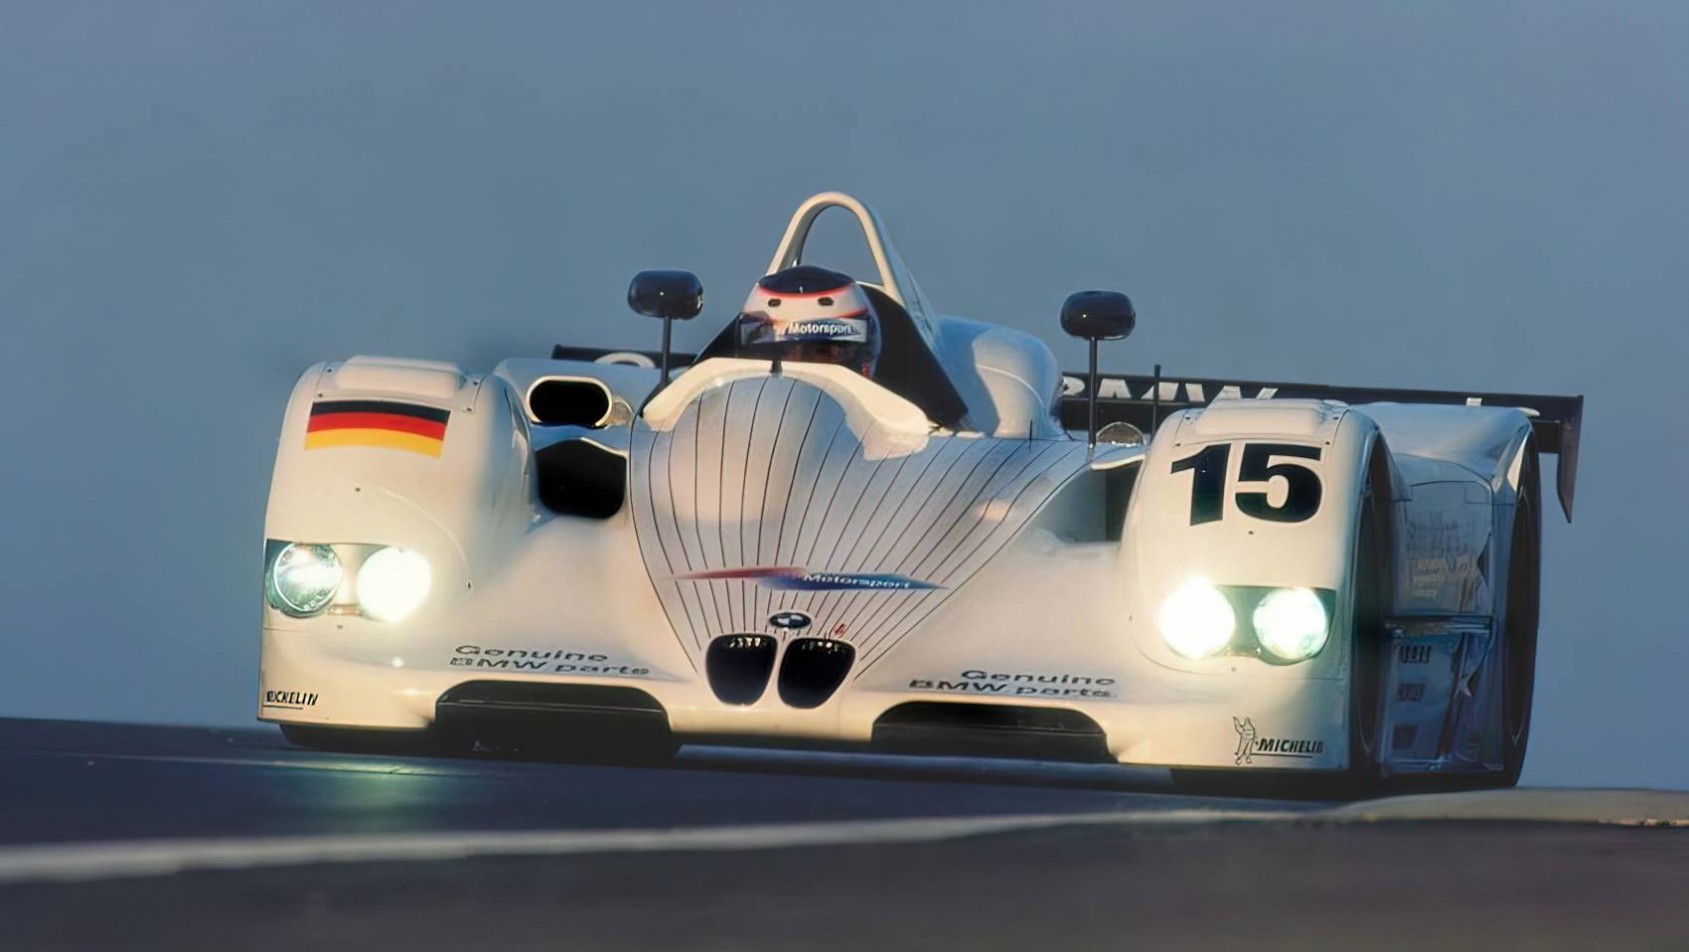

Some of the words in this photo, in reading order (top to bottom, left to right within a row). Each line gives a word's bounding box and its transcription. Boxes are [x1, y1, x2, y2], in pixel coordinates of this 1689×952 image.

[1171, 442, 1323, 526] 15
[802, 574, 911, 589] Motorsport
[455, 645, 608, 662] Genuine
[450, 657, 548, 670] BMW
[554, 664, 650, 675] parts
[961, 670, 1115, 686] Genuine
[909, 679, 1007, 692] BMW
[1016, 686, 1113, 698] parts
